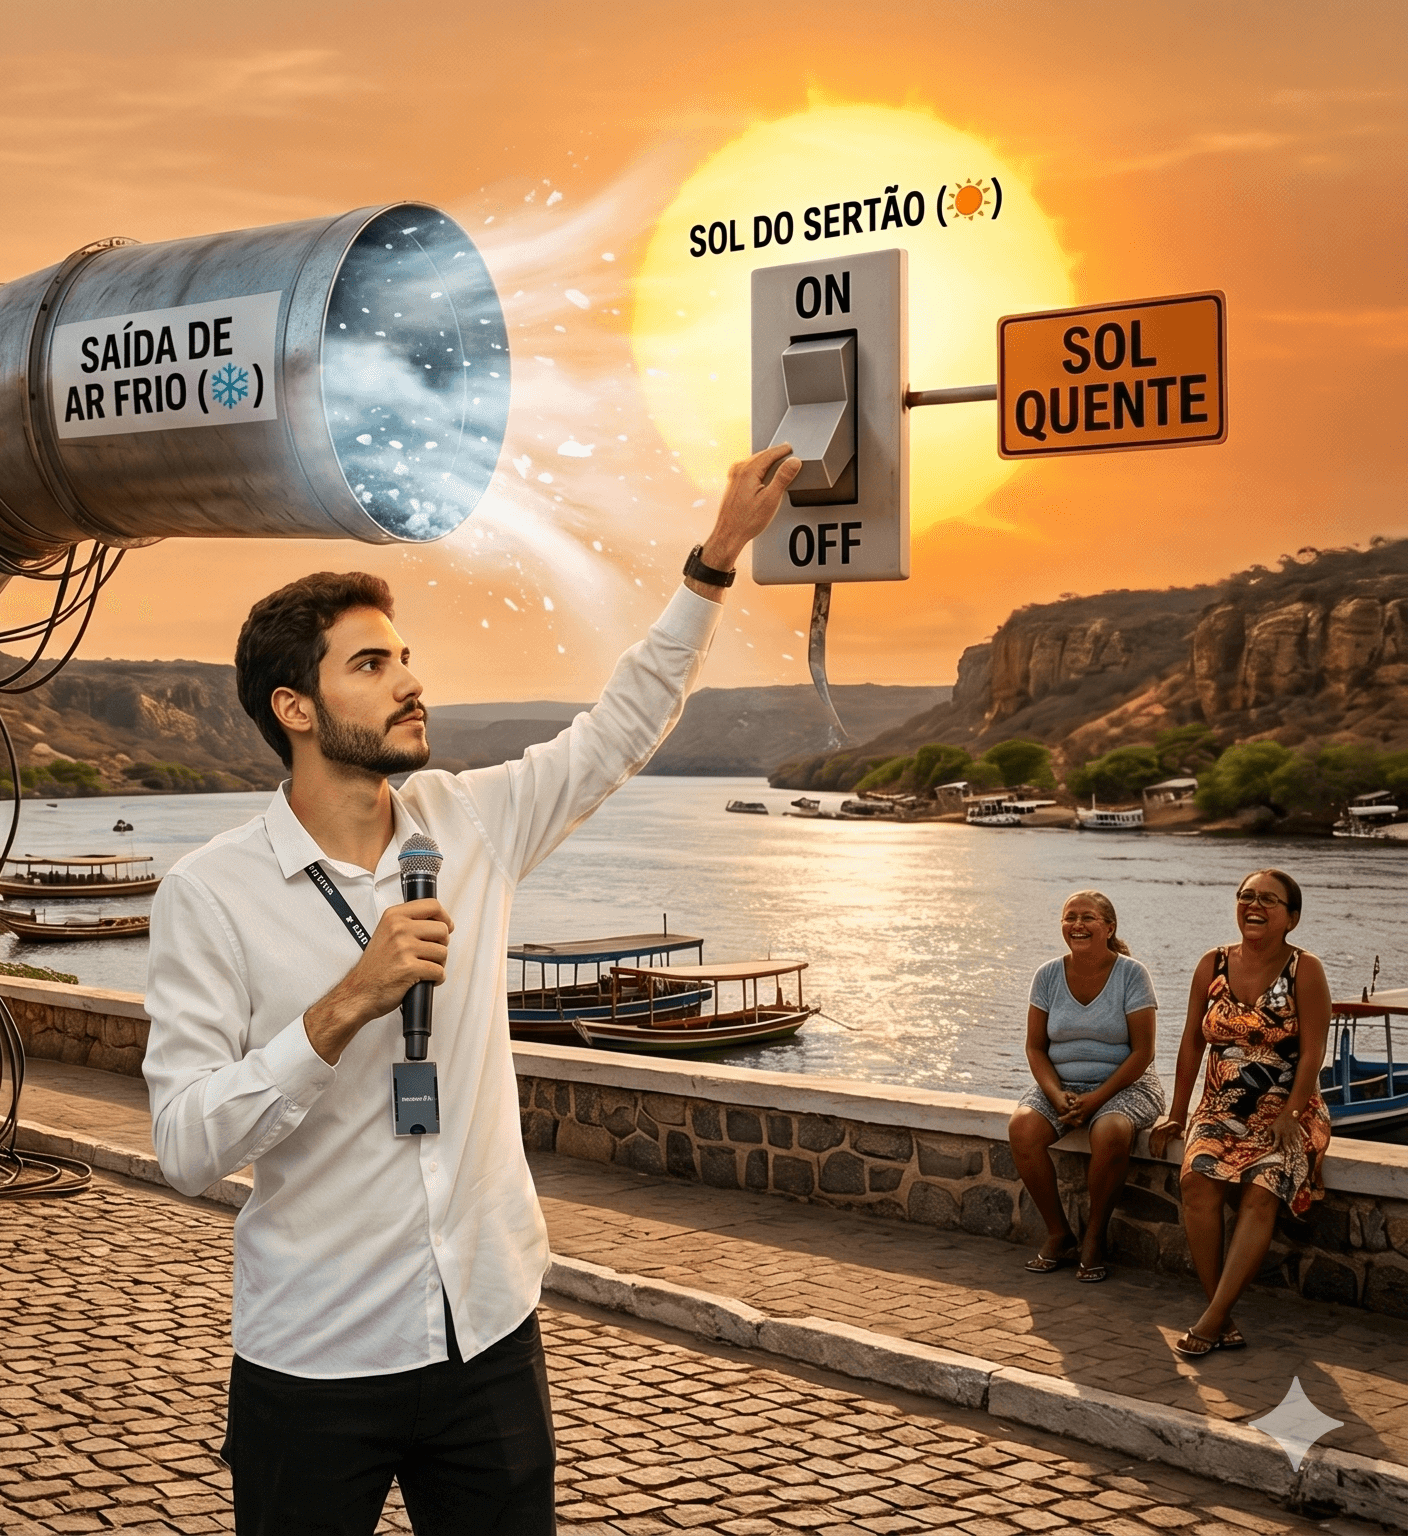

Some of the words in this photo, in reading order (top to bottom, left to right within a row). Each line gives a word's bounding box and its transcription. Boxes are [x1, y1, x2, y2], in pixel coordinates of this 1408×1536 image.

[795, 271, 851, 319] ON
[80, 321, 178, 374] SAÍDA
[188, 316, 233, 360] DE
[1062, 320, 1157, 375] SOL
[64, 384, 106, 422] AR
[113, 373, 187, 417] FRIO
[1015, 374, 1208, 442] QUENTE
[788, 522, 863, 568] OFF
